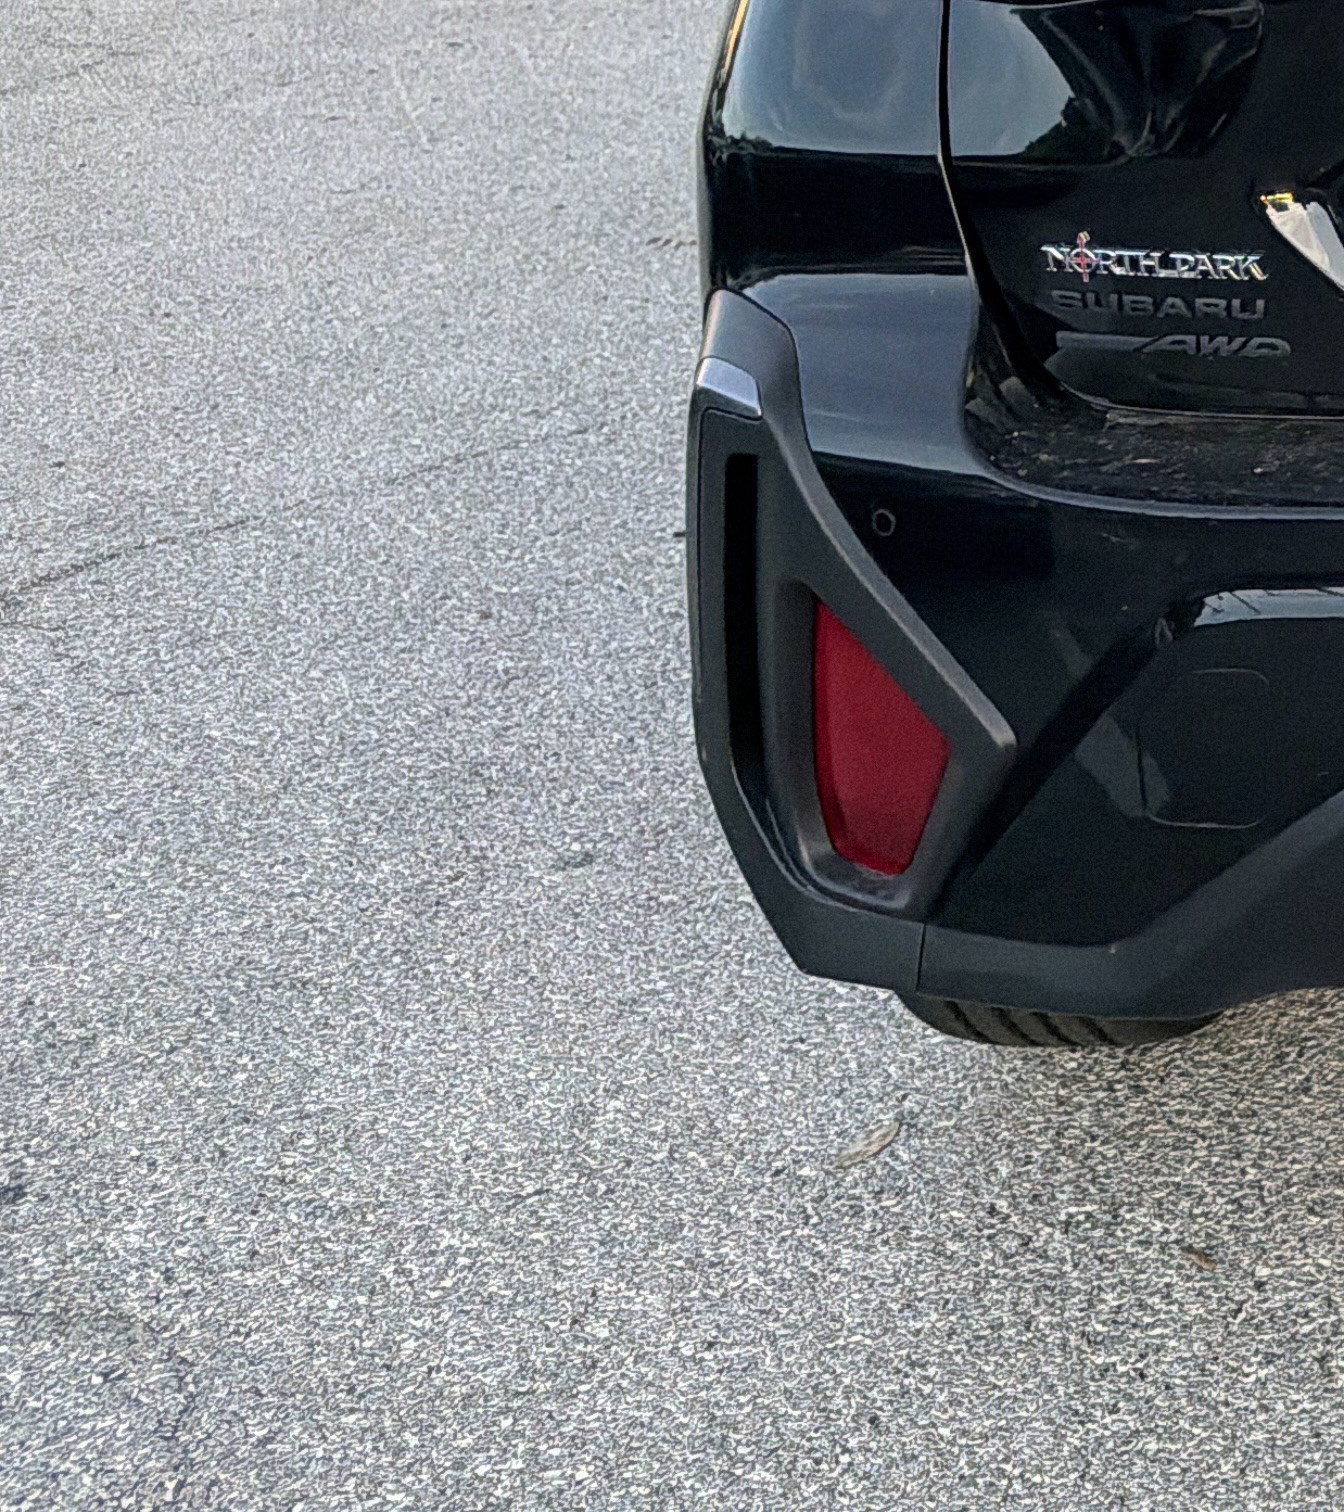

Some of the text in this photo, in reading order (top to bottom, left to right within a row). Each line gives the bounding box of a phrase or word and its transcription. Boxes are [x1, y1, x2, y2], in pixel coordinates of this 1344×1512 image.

[1040, 243, 1270, 281] NORTH PARK
[1049, 289, 1267, 321] SUBARU
[1140, 333, 1292, 358] AWD
